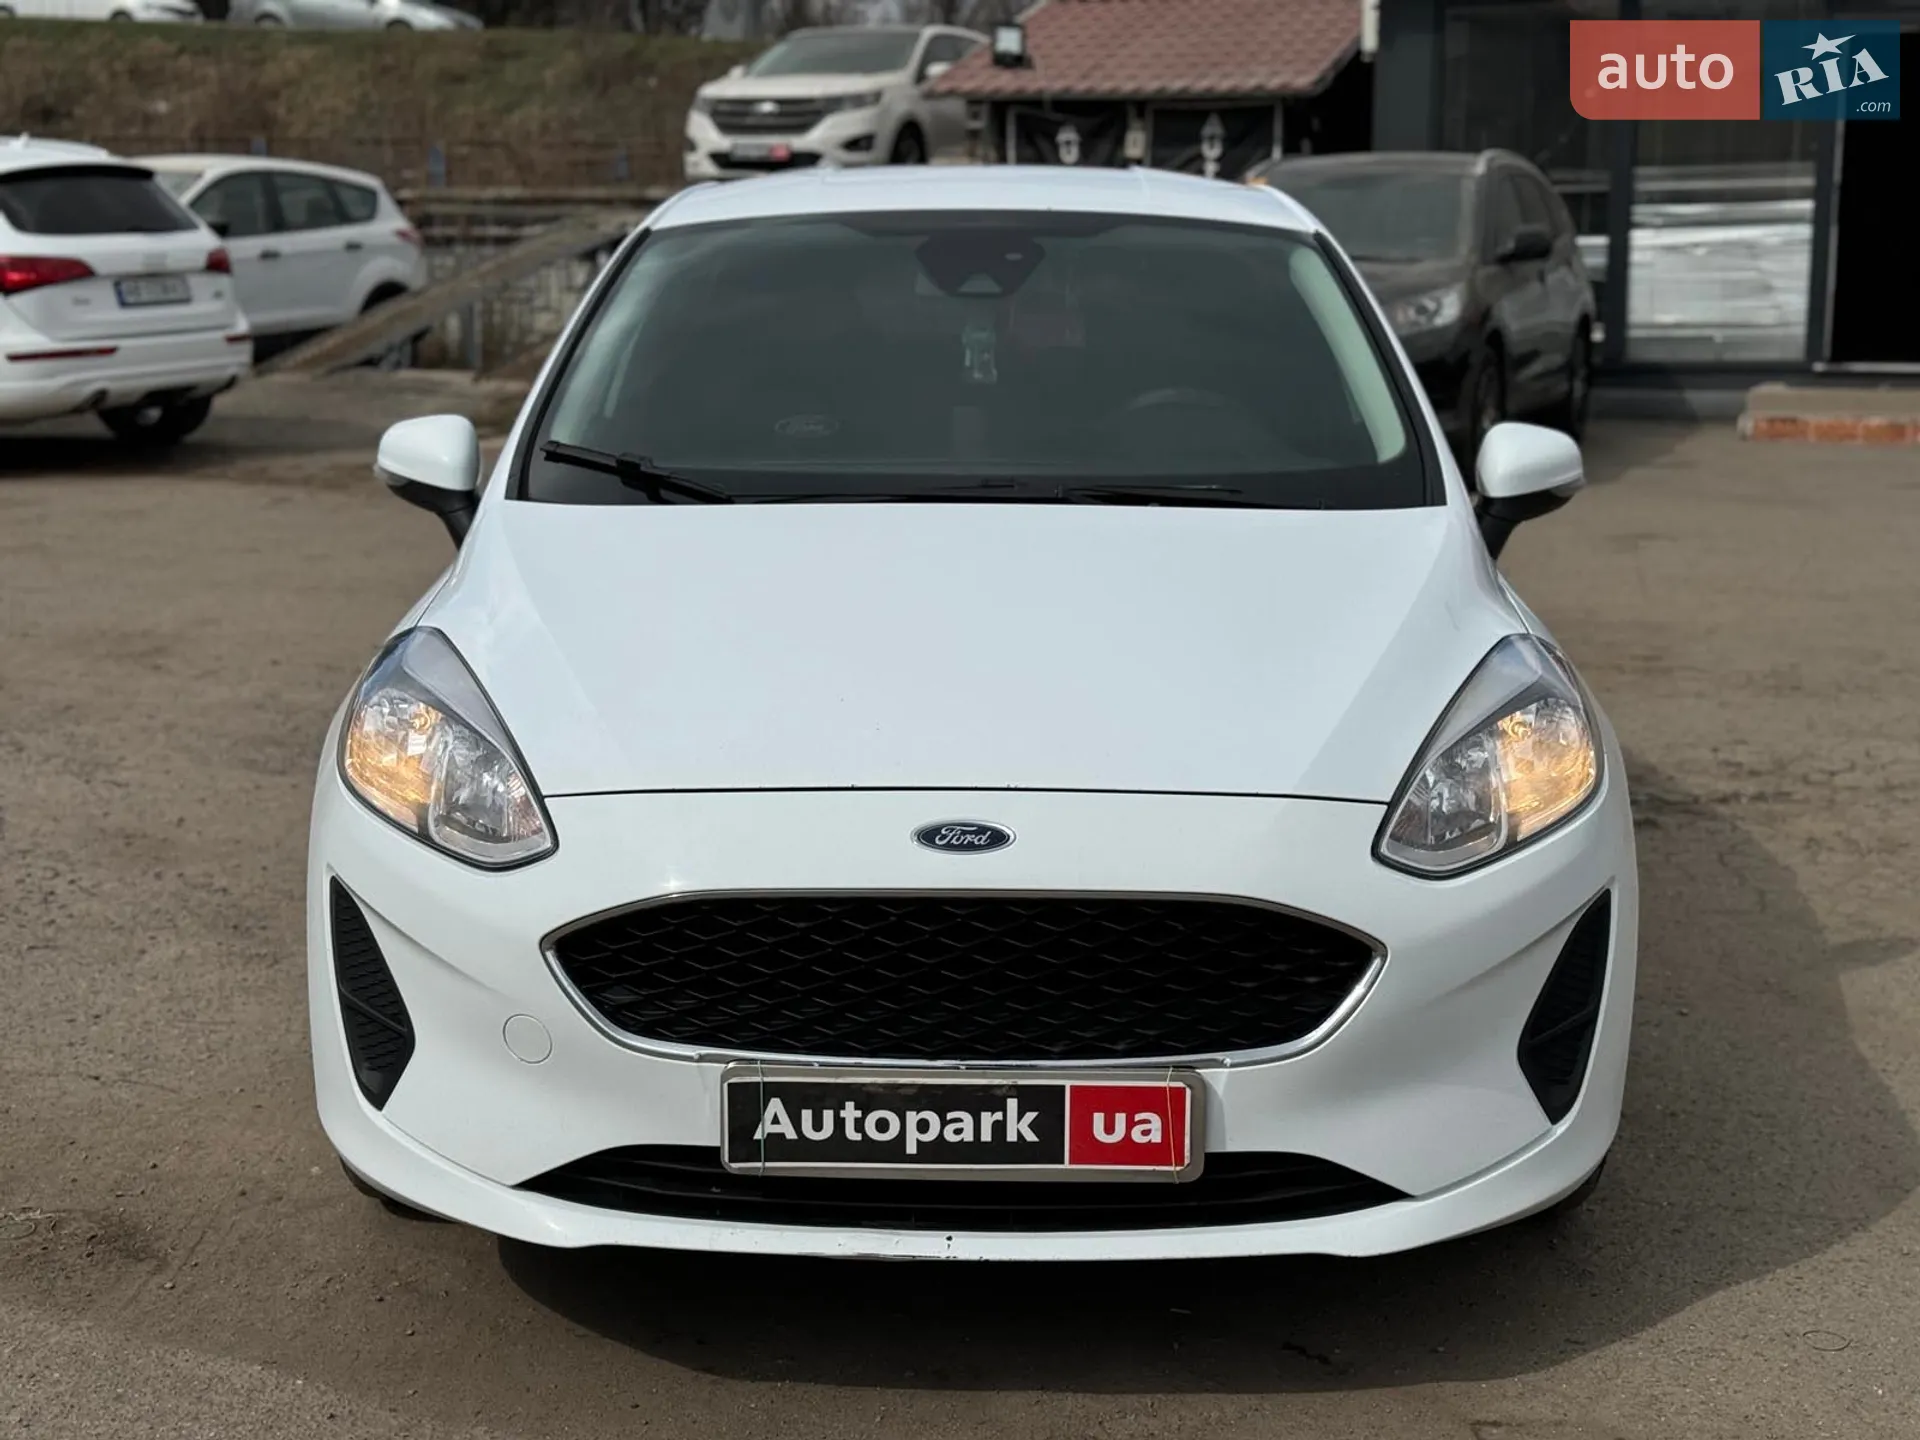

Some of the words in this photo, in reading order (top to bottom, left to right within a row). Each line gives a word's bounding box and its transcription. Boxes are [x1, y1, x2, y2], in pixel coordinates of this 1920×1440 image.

[934, 825, 991, 845] Ford
[753, 1096, 1040, 1154] Autopark
[1092, 1112, 1162, 1144] ua
